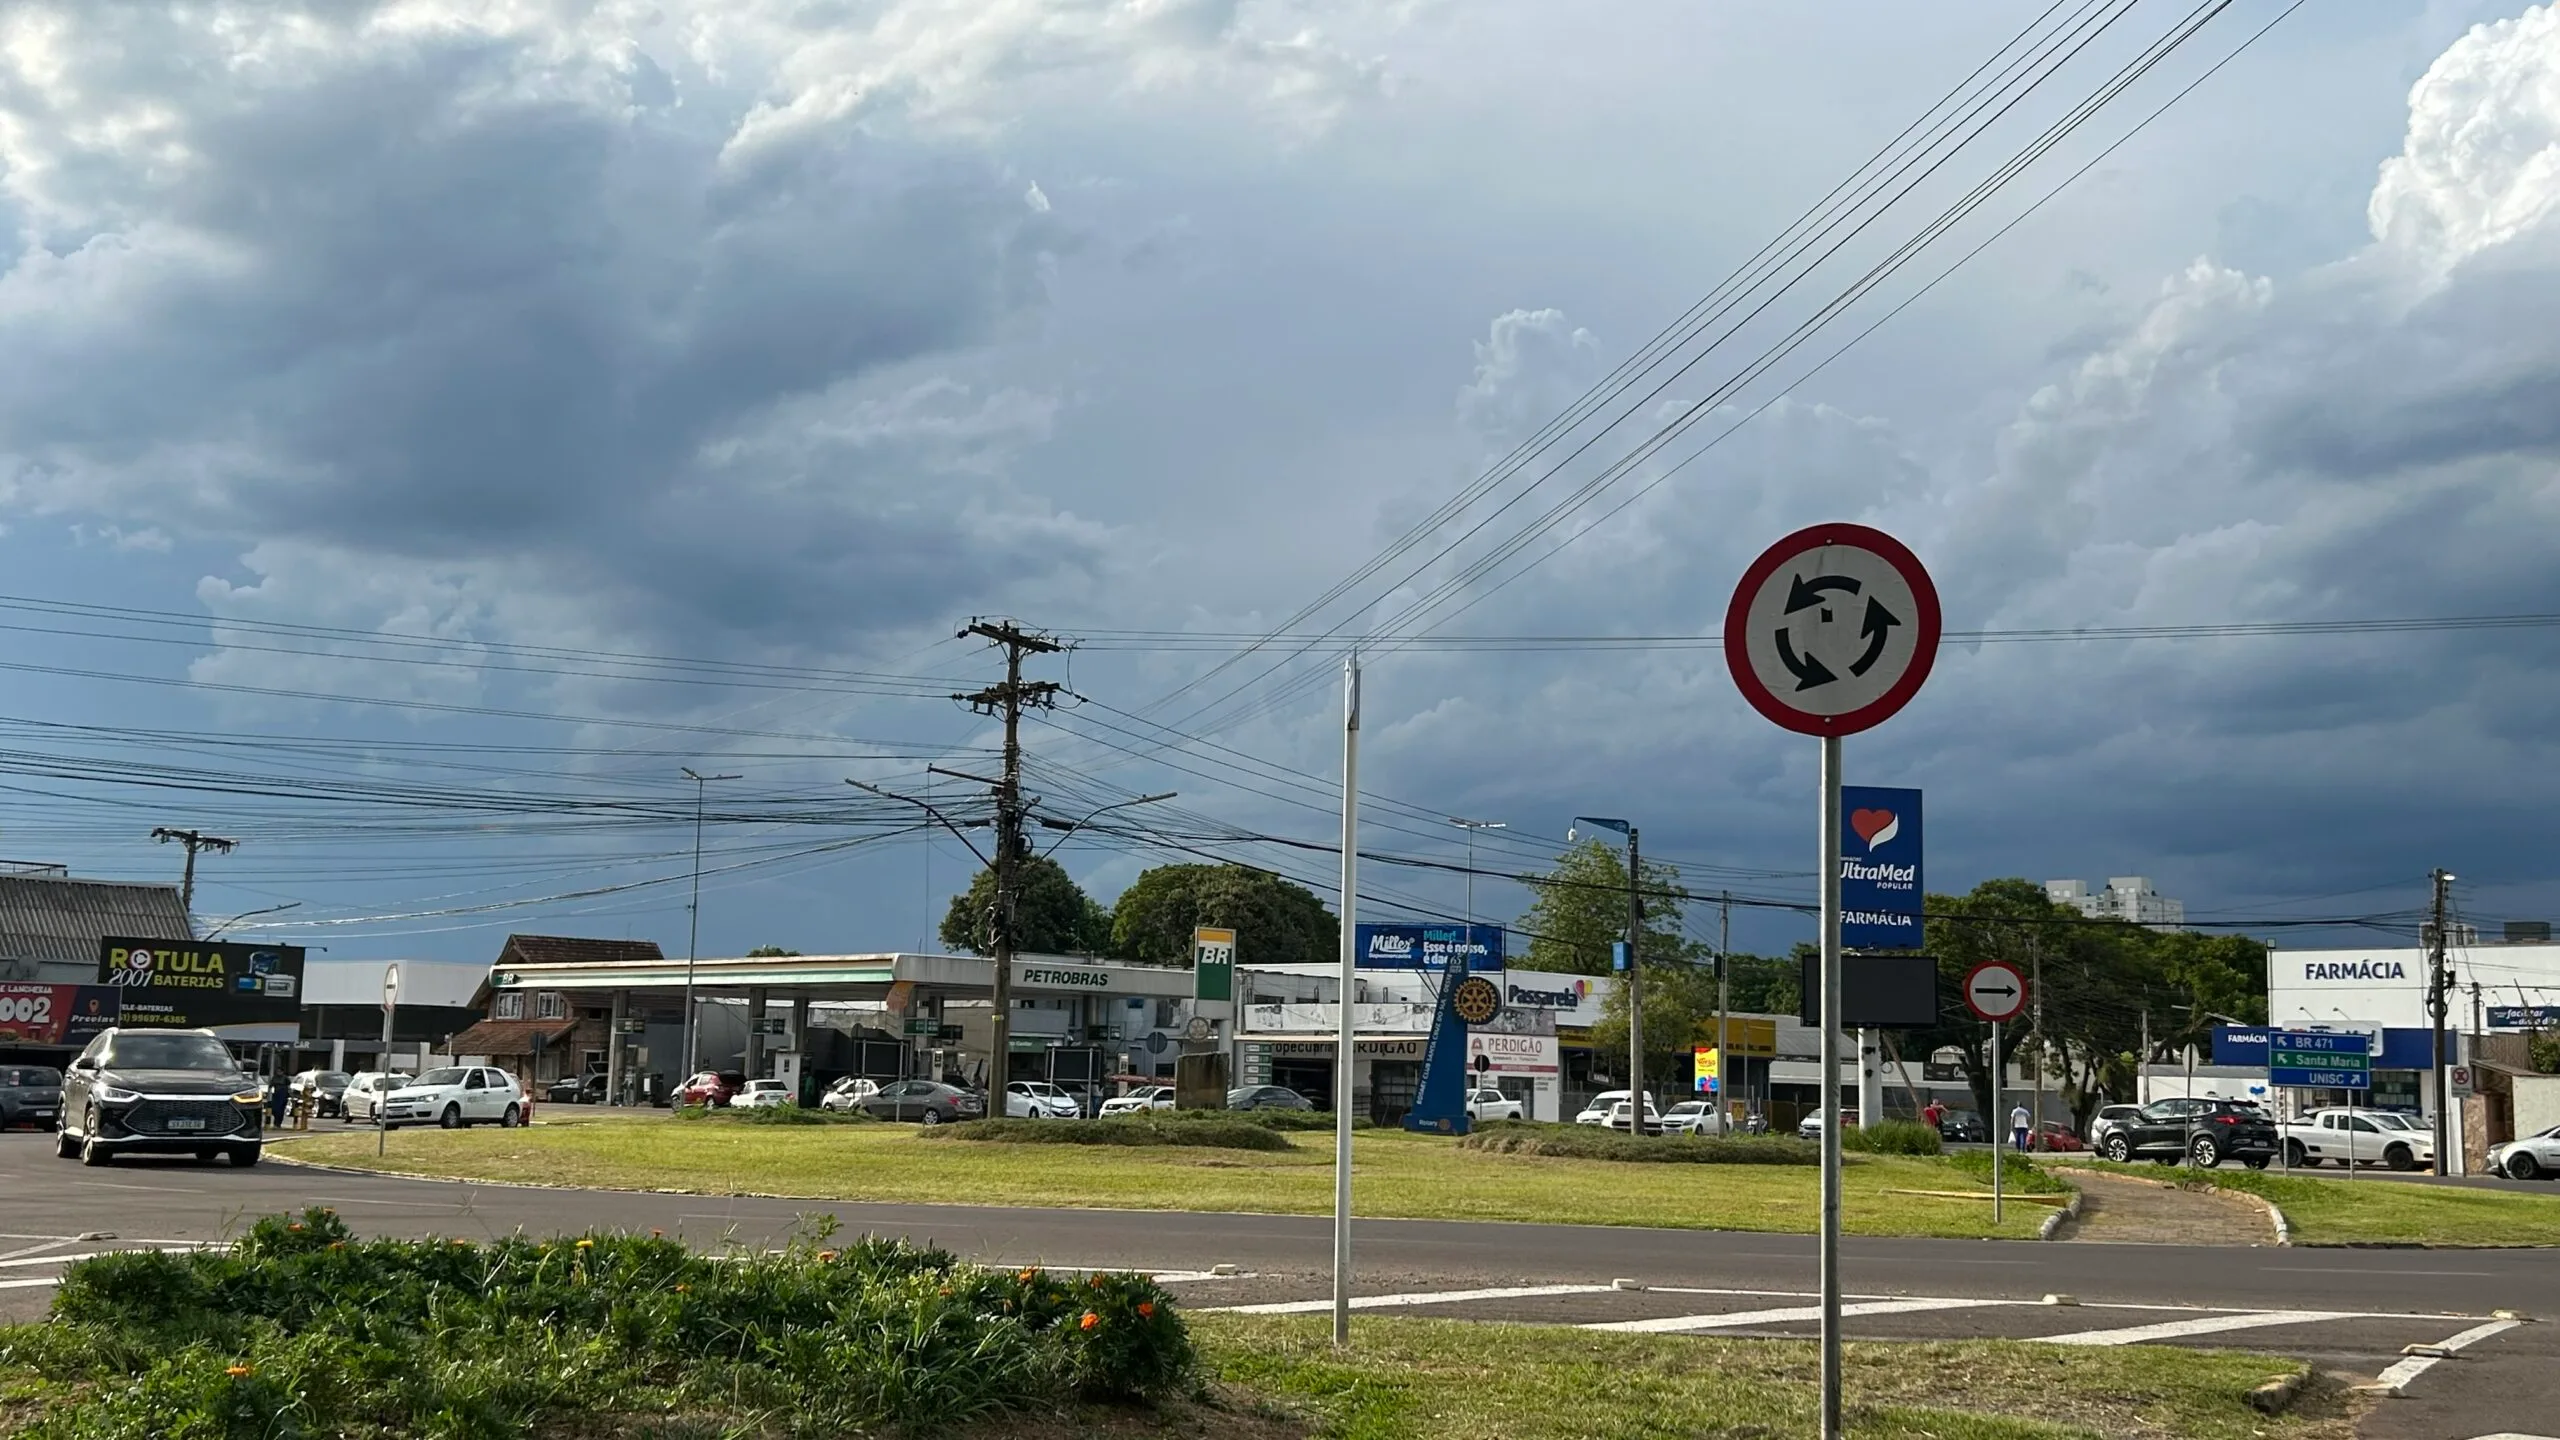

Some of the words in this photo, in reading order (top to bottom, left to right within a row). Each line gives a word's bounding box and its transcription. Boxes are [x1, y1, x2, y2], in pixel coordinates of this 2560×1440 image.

[1877, 882, 1913, 890] POPULAR
[1424, 930, 1456, 941] Miller!
[1423, 942, 1445, 952] Esse
[1447, 941, 1453, 952] é
[1455, 943, 1488, 955] nosso,
[1201, 947, 1229, 964] BR
[1423, 952, 1430, 964] é
[2306, 959, 2405, 980] FARMÁCIA
[108, 968, 154, 987] 2001
[153, 974, 224, 989] BATERIAS
[502, 973, 515, 984] BR
[1023, 969, 1108, 987] PETROBRAS
[1509, 984, 1578, 1007] Passarela
[122, 1003, 174, 1013] ELE-BATERIAS
[2227, 1033, 2267, 1043] FARMÁCIA
[2295, 1038, 2313, 1048] BR
[2314, 1038, 2333, 1049] 471
[1488, 1037, 1542, 1054] PERDIGÃO
[2296, 1055, 2328, 1067] Santa
[2330, 1056, 2360, 1068] Maria
[2309, 1073, 2345, 1085] UNISC
